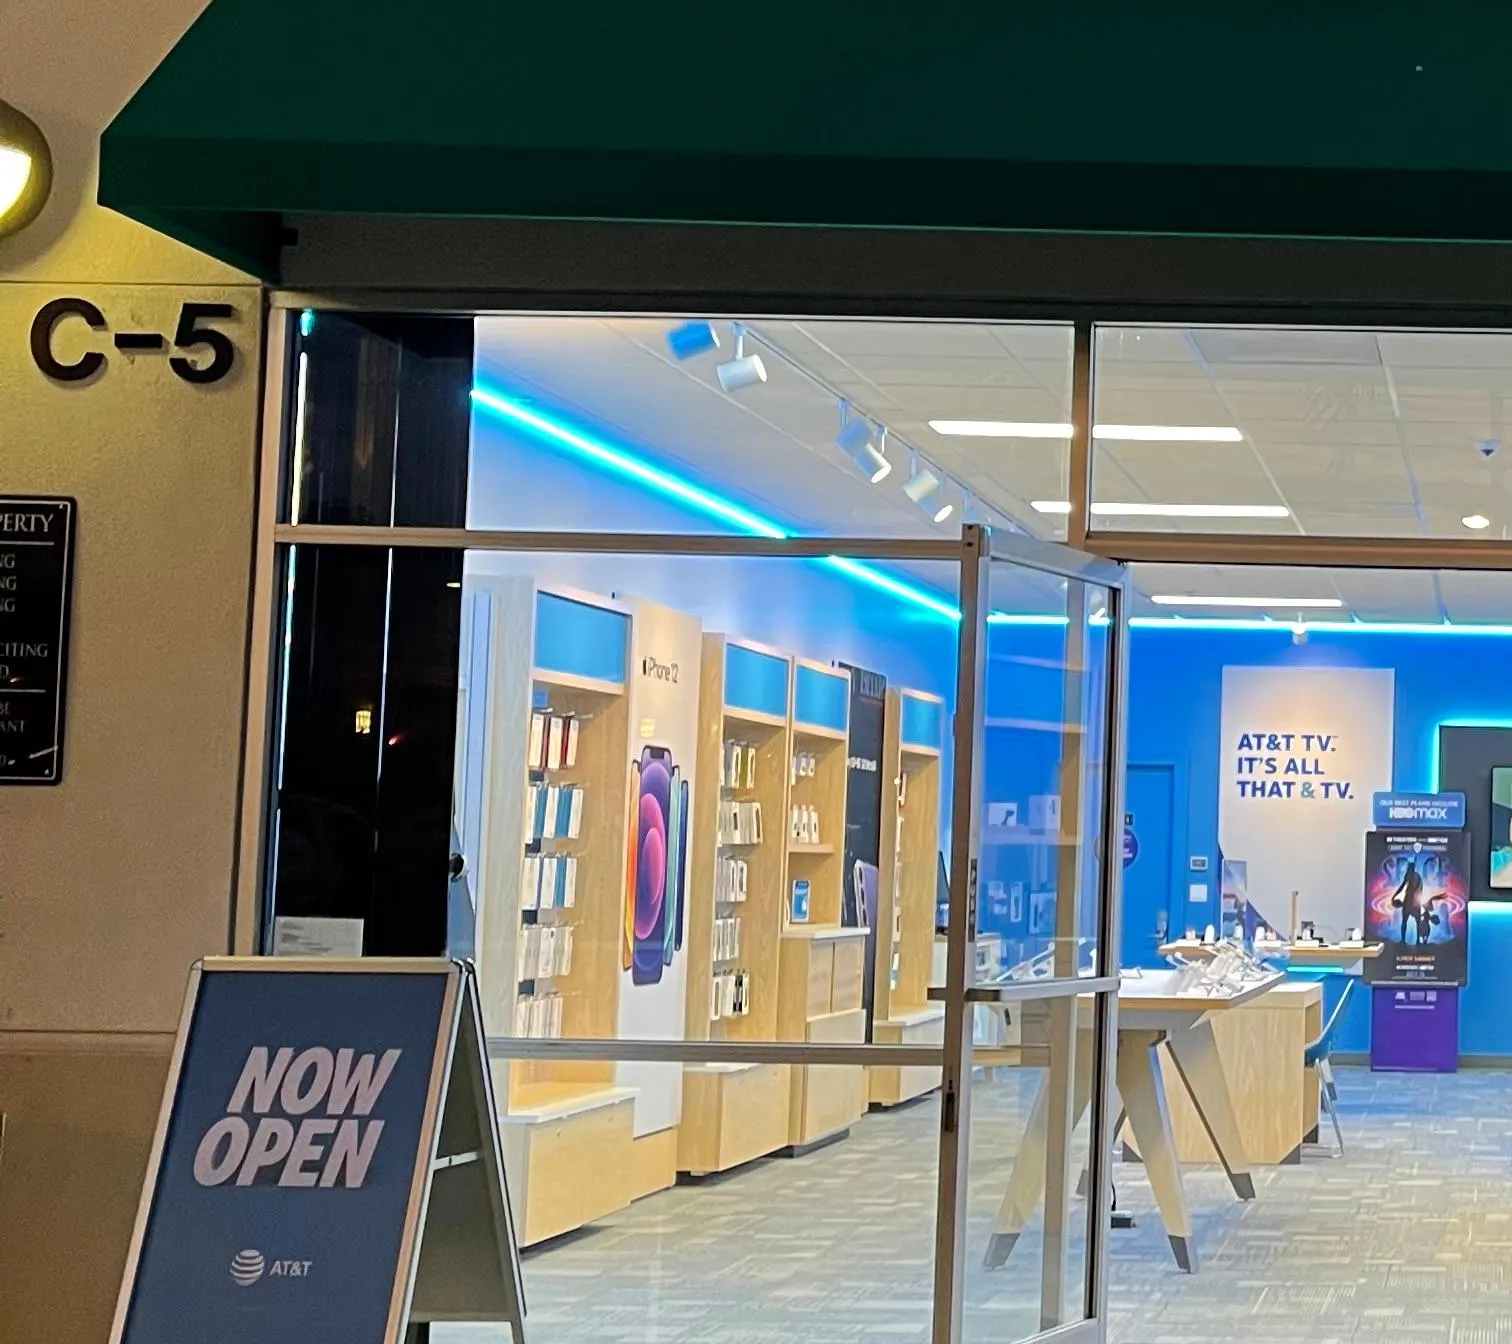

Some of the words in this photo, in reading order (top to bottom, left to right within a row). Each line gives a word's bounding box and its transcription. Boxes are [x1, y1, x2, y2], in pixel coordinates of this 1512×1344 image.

[31, 298, 233, 384] C-5
[1237, 733, 1295, 751] AT&T
[1237, 757, 1277, 774] IT'S
[1284, 758, 1324, 775] ALL
[1237, 781, 1296, 798] THAT
[1301, 782, 1316, 799] &
[1320, 782, 1354, 800] TV.
[226, 1047, 403, 1116] NOW
[193, 1117, 386, 1188] OPEN
[270, 1260, 312, 1277] AT&T
